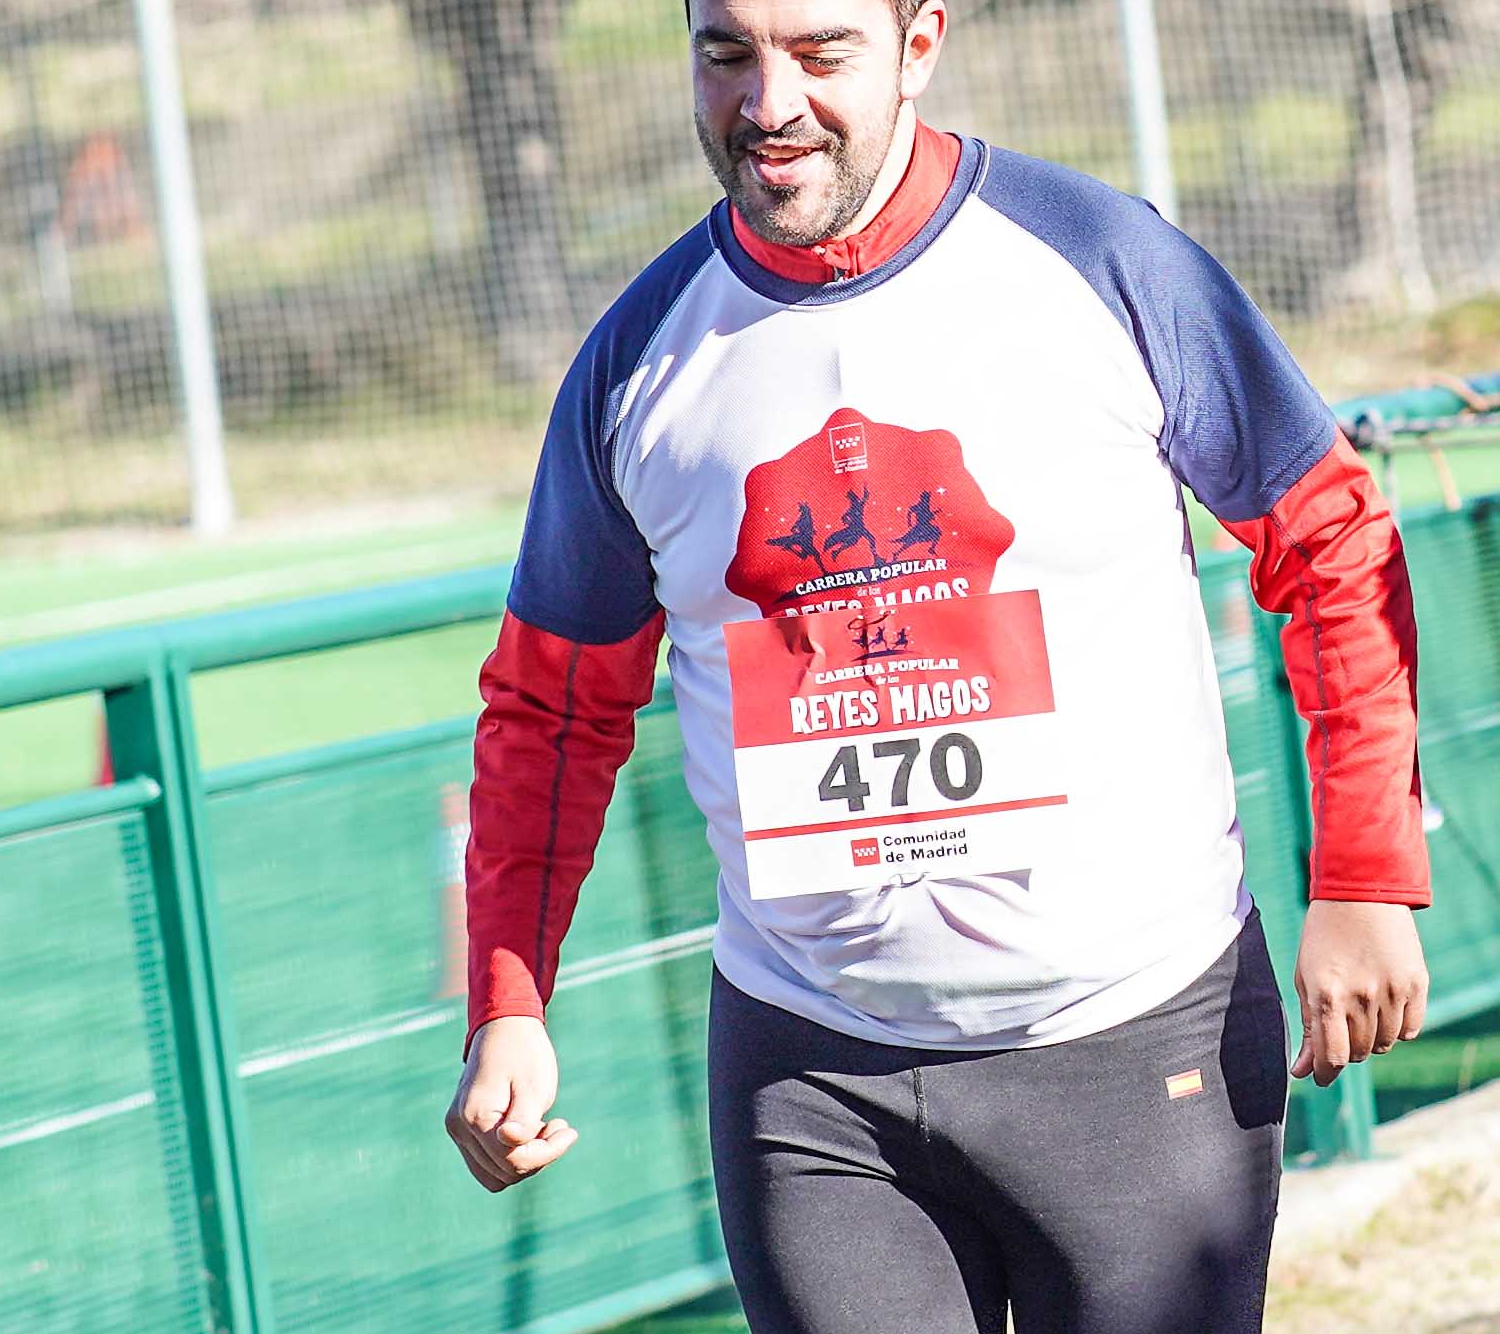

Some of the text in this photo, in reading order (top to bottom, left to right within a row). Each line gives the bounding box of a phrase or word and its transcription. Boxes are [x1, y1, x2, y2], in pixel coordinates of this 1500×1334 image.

[795, 569, 869, 596] CARRERA
[870, 558, 948, 582] POPULAR
[814, 658, 960, 685] CARRERA POPULAR
[789, 675, 991, 735] REYES MAGOS
[818, 732, 983, 812] 470
[883, 827, 966, 847] Comunidad
[885, 843, 968, 863] de Madrid
